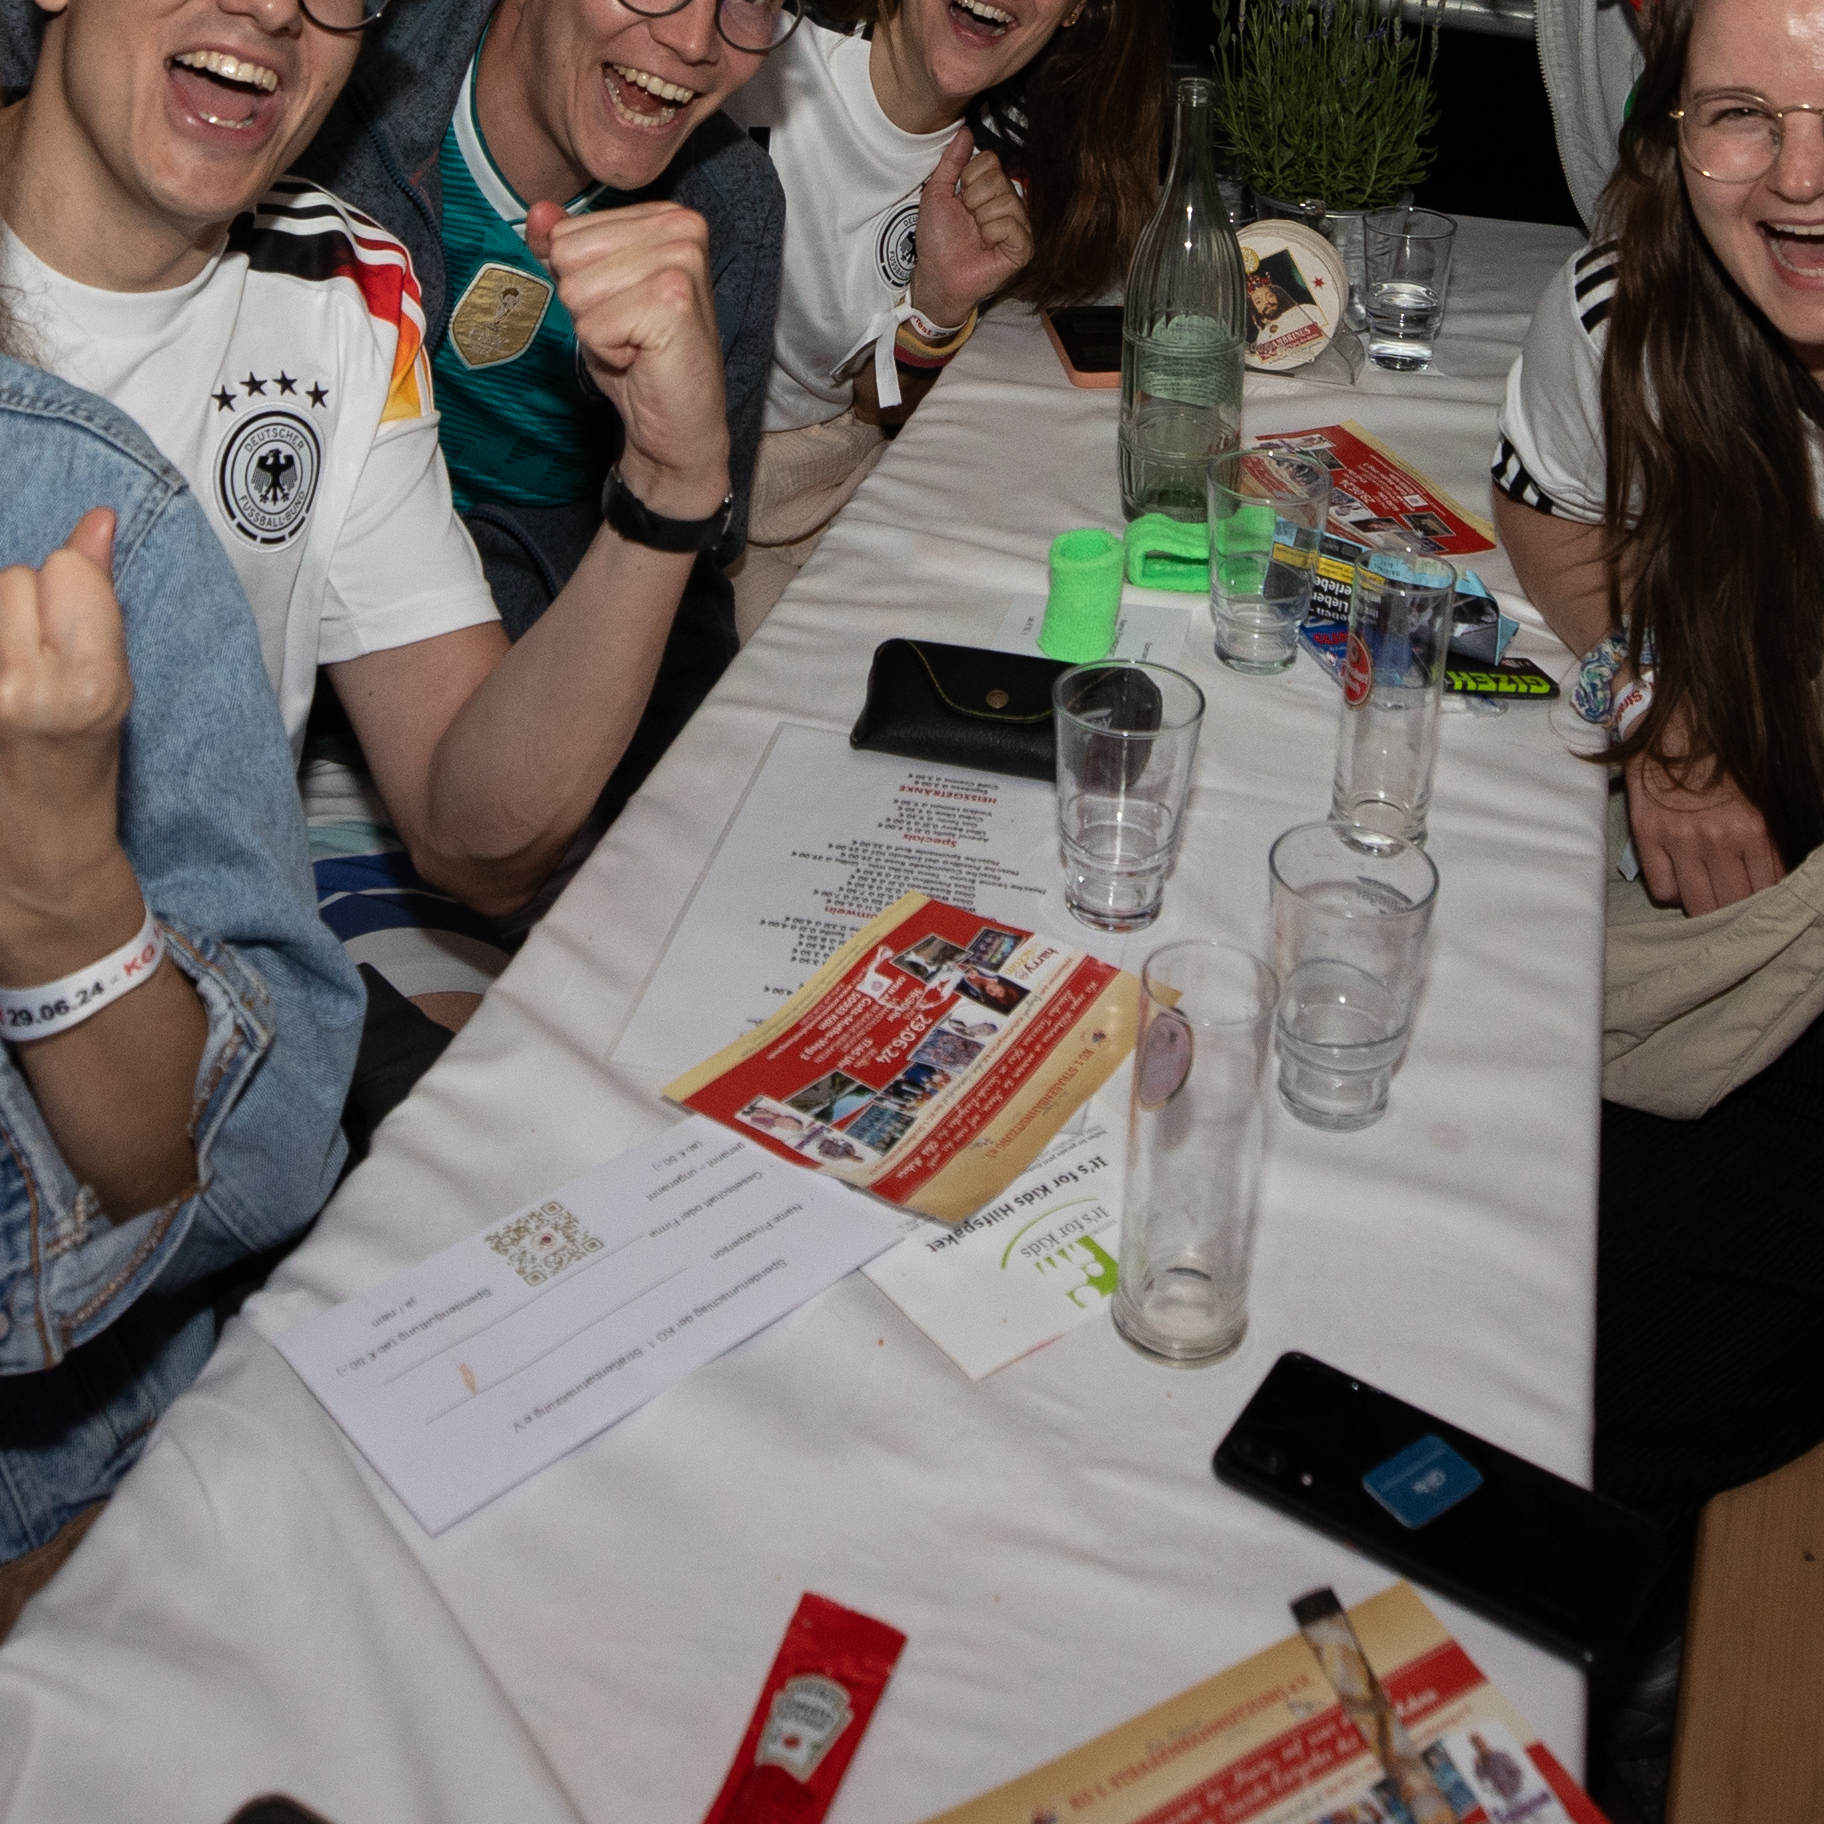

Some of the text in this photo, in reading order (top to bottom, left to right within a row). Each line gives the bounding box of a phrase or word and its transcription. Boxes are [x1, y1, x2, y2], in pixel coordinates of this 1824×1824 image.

[243, 427, 305, 454] DEUTSCHER
[237, 488, 306, 528] FUSSBALL-BUND
[1446, 670, 1549, 694] GIZEH
[898, 784, 997, 806] HEISSGETRÄNKE
[902, 832, 956, 848] Specials
[6, 980, 104, 1027] 29.06.24
[873, 1013, 932, 1067] 29.06.24
[644, 1168, 762, 1239] Gesellschaft oder Firma
[924, 1154, 1108, 1254] It's for Kids Hilfspaket
[1082, 1204, 1110, 1225] It's
[706, 1201, 802, 1261] Name Privatperson
[1057, 1218, 1084, 1239] for
[1019, 1232, 1059, 1259] Kids
[689, 1258, 786, 1319] Spendenumschlag
[672, 1315, 690, 1331] der
